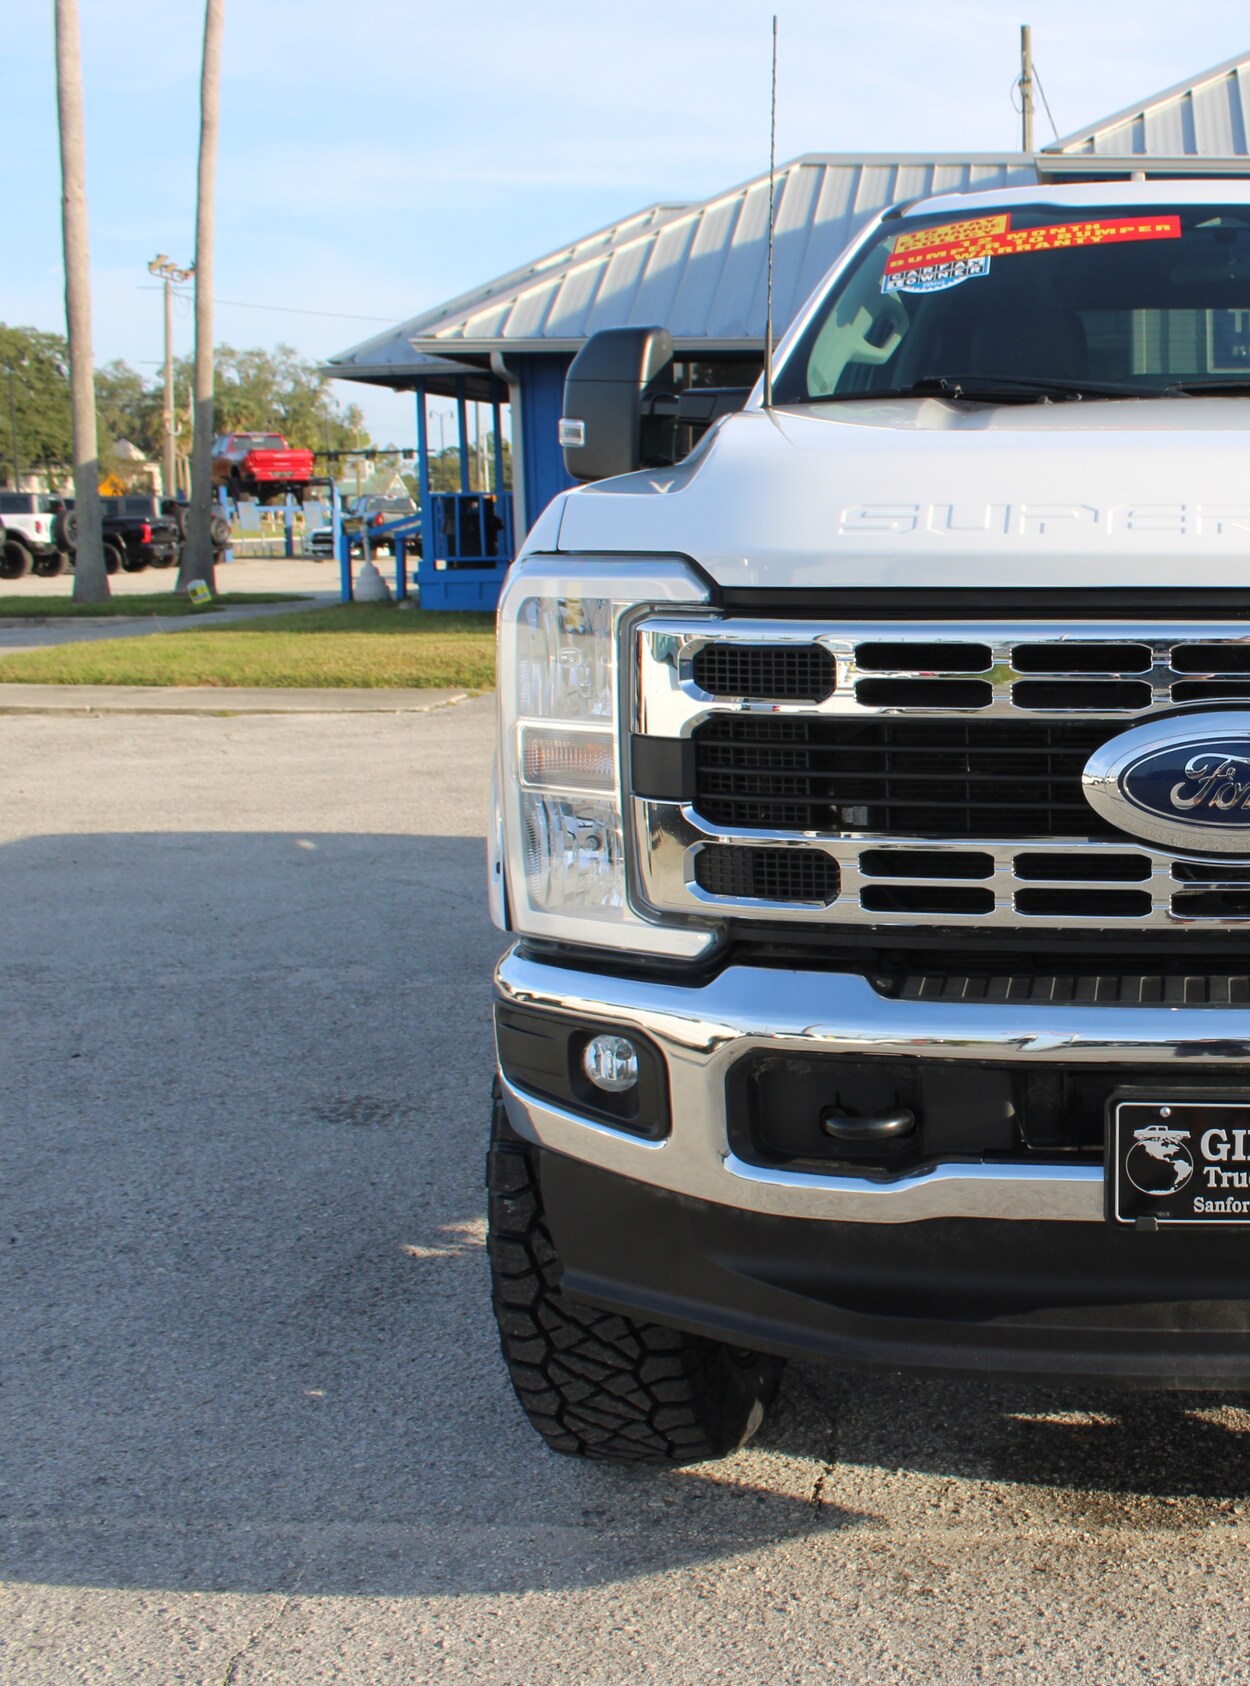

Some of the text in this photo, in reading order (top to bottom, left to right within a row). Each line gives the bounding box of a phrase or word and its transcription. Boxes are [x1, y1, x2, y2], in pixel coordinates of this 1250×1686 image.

[890, 224, 1172, 268] BUMPER TO BUMPER
[899, 223, 1002, 247] EXCHANGE
[960, 223, 1101, 247] 12 MONTH
[954, 235, 1104, 260] WARRANTY
[891, 258, 984, 281] CARFAX
[905, 266, 982, 286] OWNER
